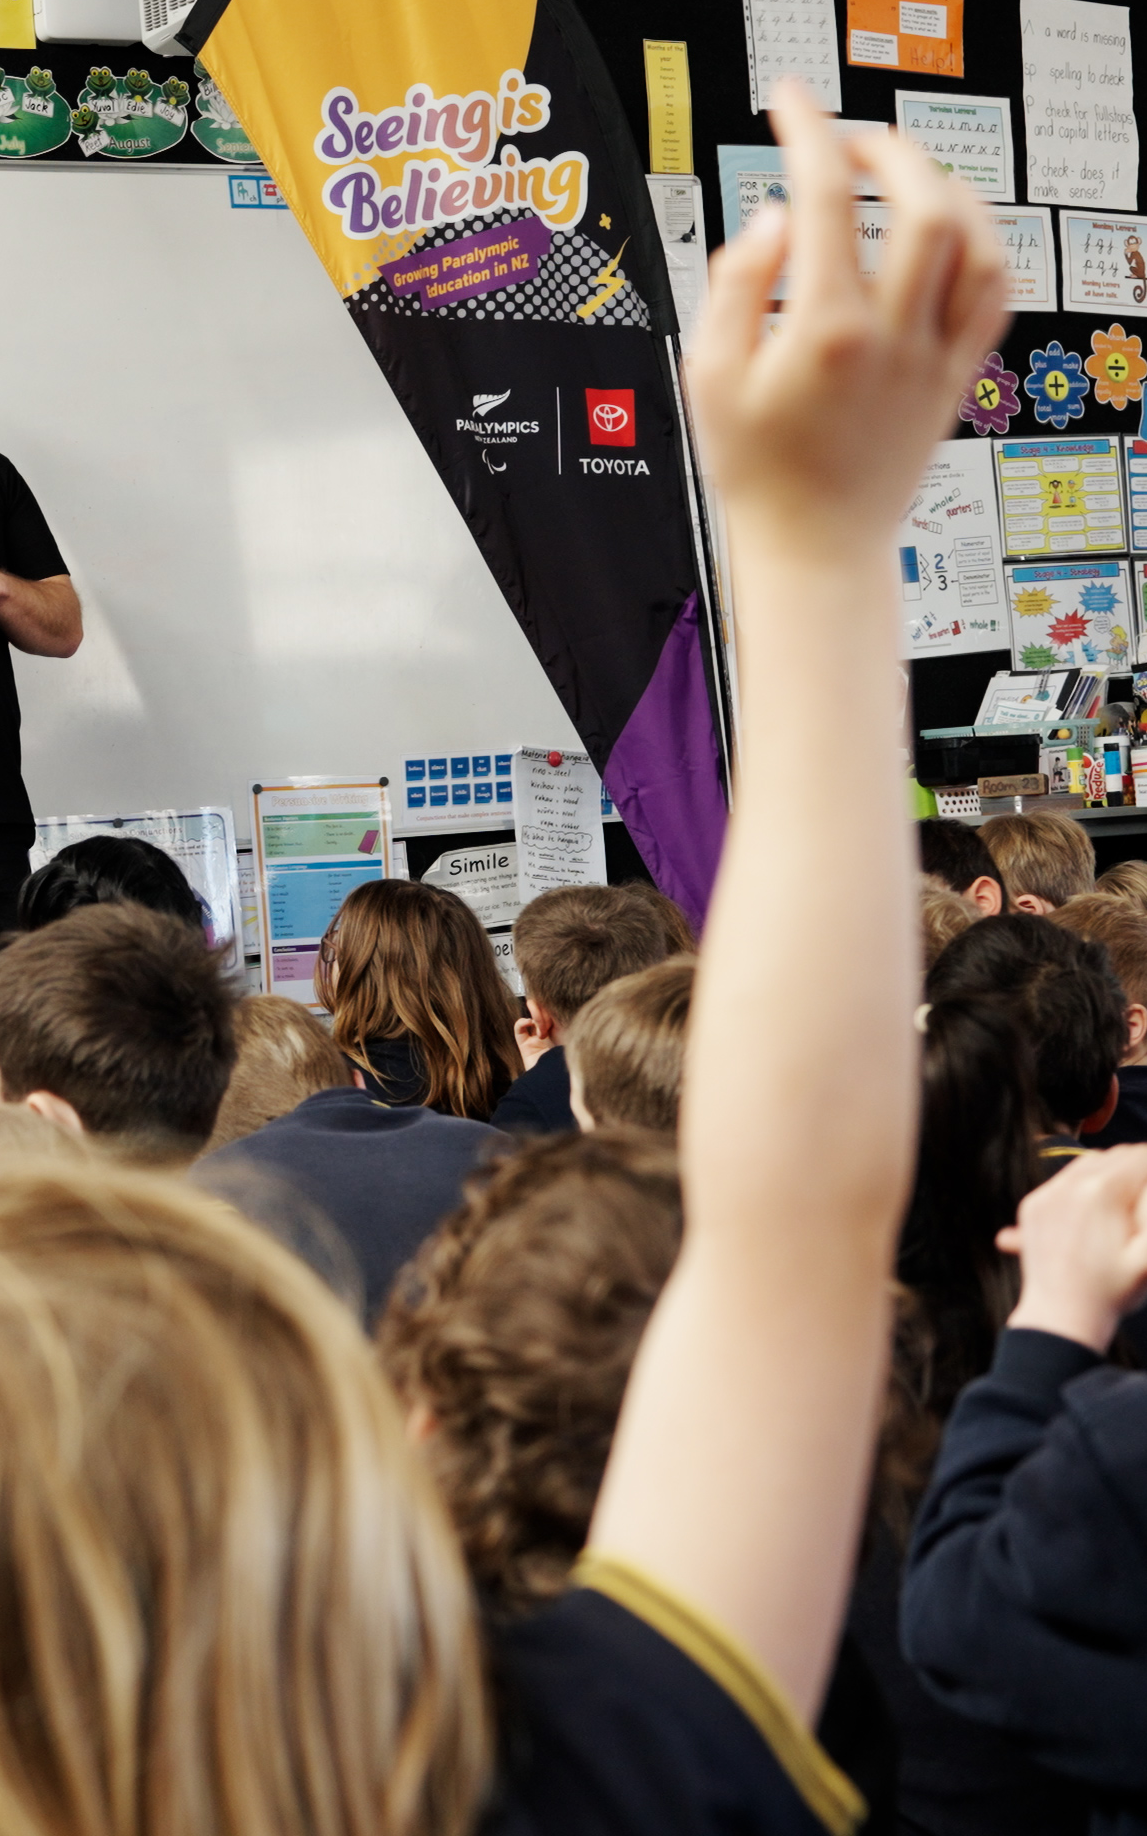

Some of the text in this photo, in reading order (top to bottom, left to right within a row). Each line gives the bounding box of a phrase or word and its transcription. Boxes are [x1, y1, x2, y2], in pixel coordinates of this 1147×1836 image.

[1045, 22, 1126, 55] a word is missing
[1025, 62, 1125, 89] sp spelling to check
[26, 100, 49, 114] Jack
[92, 99, 115, 113] Yuval
[126, 101, 146, 114] Edie
[160, 106, 175, 121] Joy
[1045, 99, 1133, 127] check for fullstops
[321, 77, 544, 163] Seeing is
[1034, 122, 1130, 144] and capital letters
[108, 137, 151, 155] August
[1080, 161, 1104, 180] does
[1112, 161, 1120, 180] it
[329, 152, 583, 234] Believing
[740, 181, 757, 191] FOR
[1034, 181, 1106, 199] make sense?
[741, 194, 759, 204] AND
[393, 236, 520, 288] Growing Paralympic
[426, 254, 530, 299] Education in NZ
[1035, 361, 1047, 369] plus
[1063, 362, 1079, 370] make
[456, 419, 540, 434] PARALYMPICS
[483, 436, 518, 444] ZEALAND
[1056, 444, 1094, 454] Knowledge
[579, 458, 650, 476] TOYOTA
[929, 495, 954, 514] whole
[946, 504, 972, 519] quarters
[934, 553, 945, 570] 2
[938, 575, 947, 591] 3
[983, 778, 1039, 793] Room 23
[1094, 762, 1104, 800] Reduce
[271, 794, 328, 808] Persuasive
[449, 852, 509, 876] Simile
